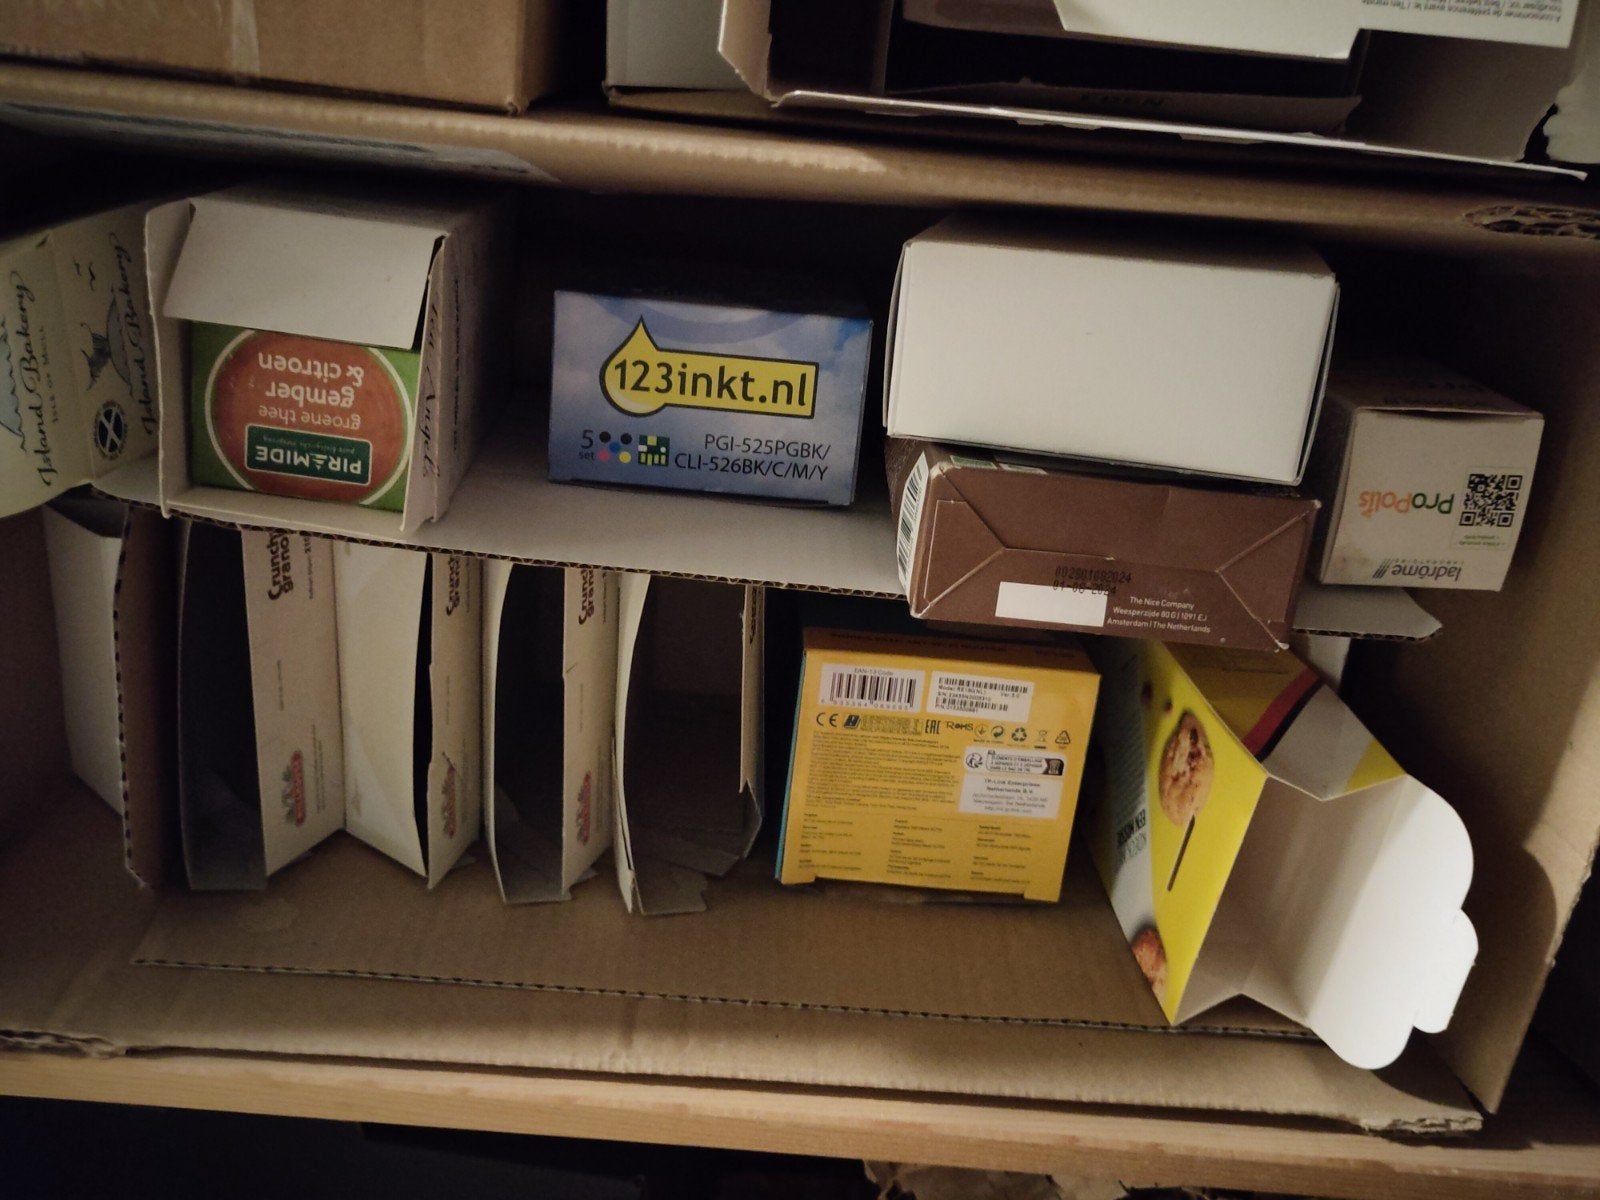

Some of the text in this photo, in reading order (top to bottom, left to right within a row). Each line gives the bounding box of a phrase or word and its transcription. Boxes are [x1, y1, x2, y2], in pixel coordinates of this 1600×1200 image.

[109, 232, 158, 435] Island Bakery
[9, 271, 58, 486] Island Bakery
[257, 352, 365, 387] & citroen
[613, 357, 808, 408] 123inkt.nl
[265, 381, 355, 409] gember
[258, 405, 361, 432] groene thee
[581, 429, 594, 448] 5
[704, 432, 832, 461] PGI-525PGBK/
[578, 450, 595, 462] set
[674, 451, 829, 482] CLI-526BK/C/M/Y
[1358, 491, 1456, 518] ProPolis
[277, 535, 294, 594] grano
[1113, 606, 1160, 618] Weesperzijde
[1129, 596, 1196, 611] The Nice Company
[1106, 617, 1149, 628] Amsterdam
[1153, 620, 1166, 630] The
[1166, 622, 1212, 634] Netherlands
